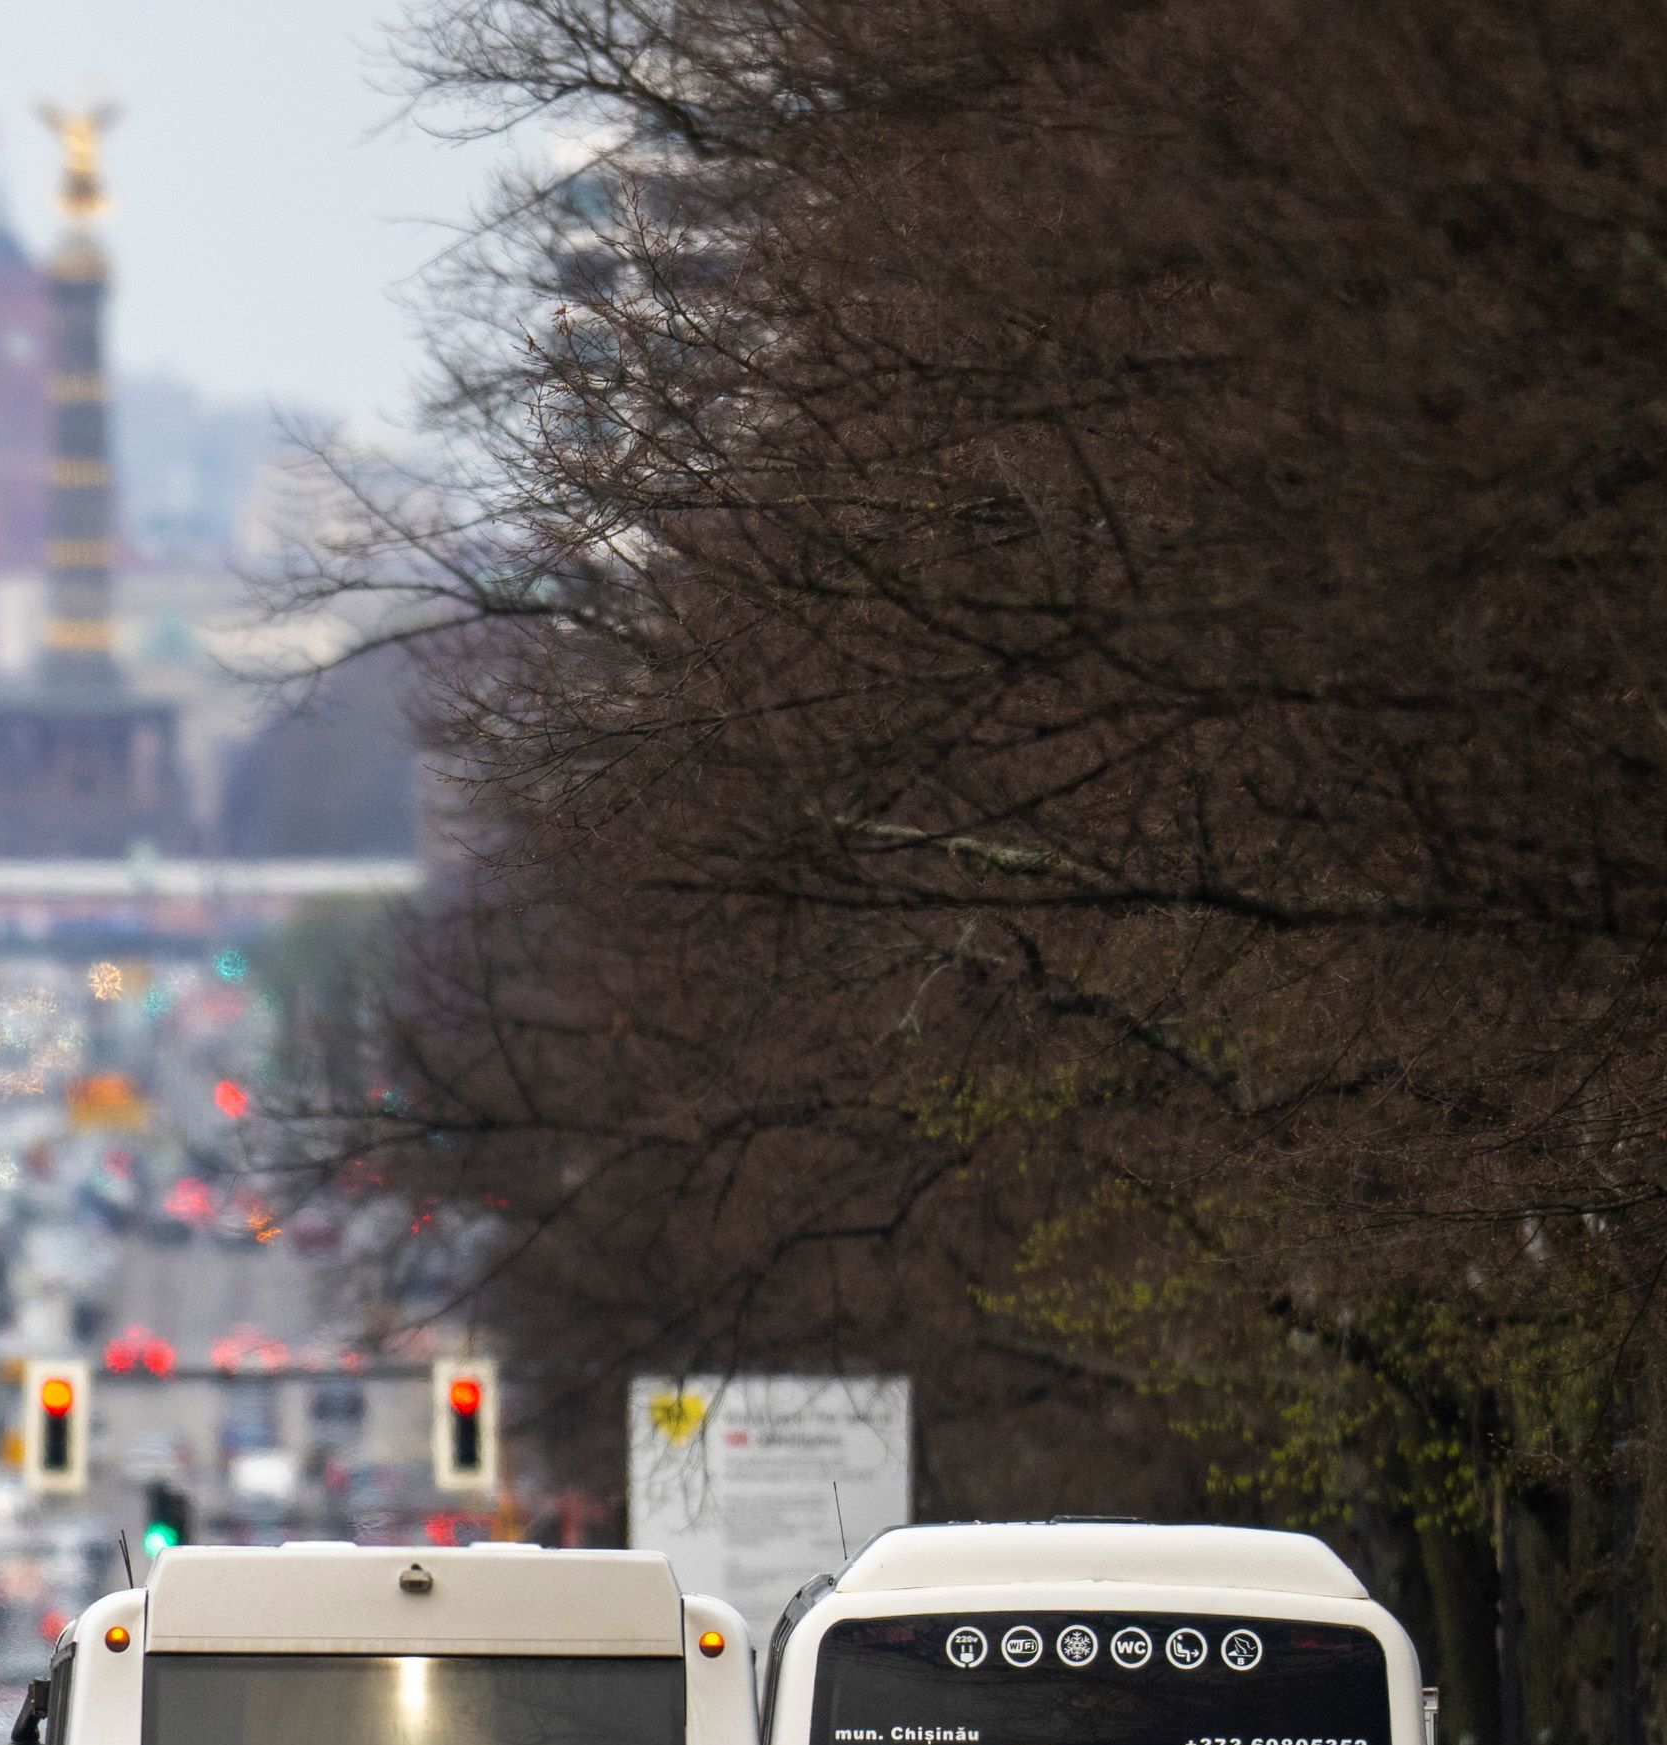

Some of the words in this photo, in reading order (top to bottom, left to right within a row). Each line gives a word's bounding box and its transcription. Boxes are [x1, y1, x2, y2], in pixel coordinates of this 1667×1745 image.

[955, 1635, 979, 1643] 220v
[1117, 1640, 1146, 1655] WC
[1237, 1657, 1245, 1665] B
[835, 1728, 884, 1741] mun.
